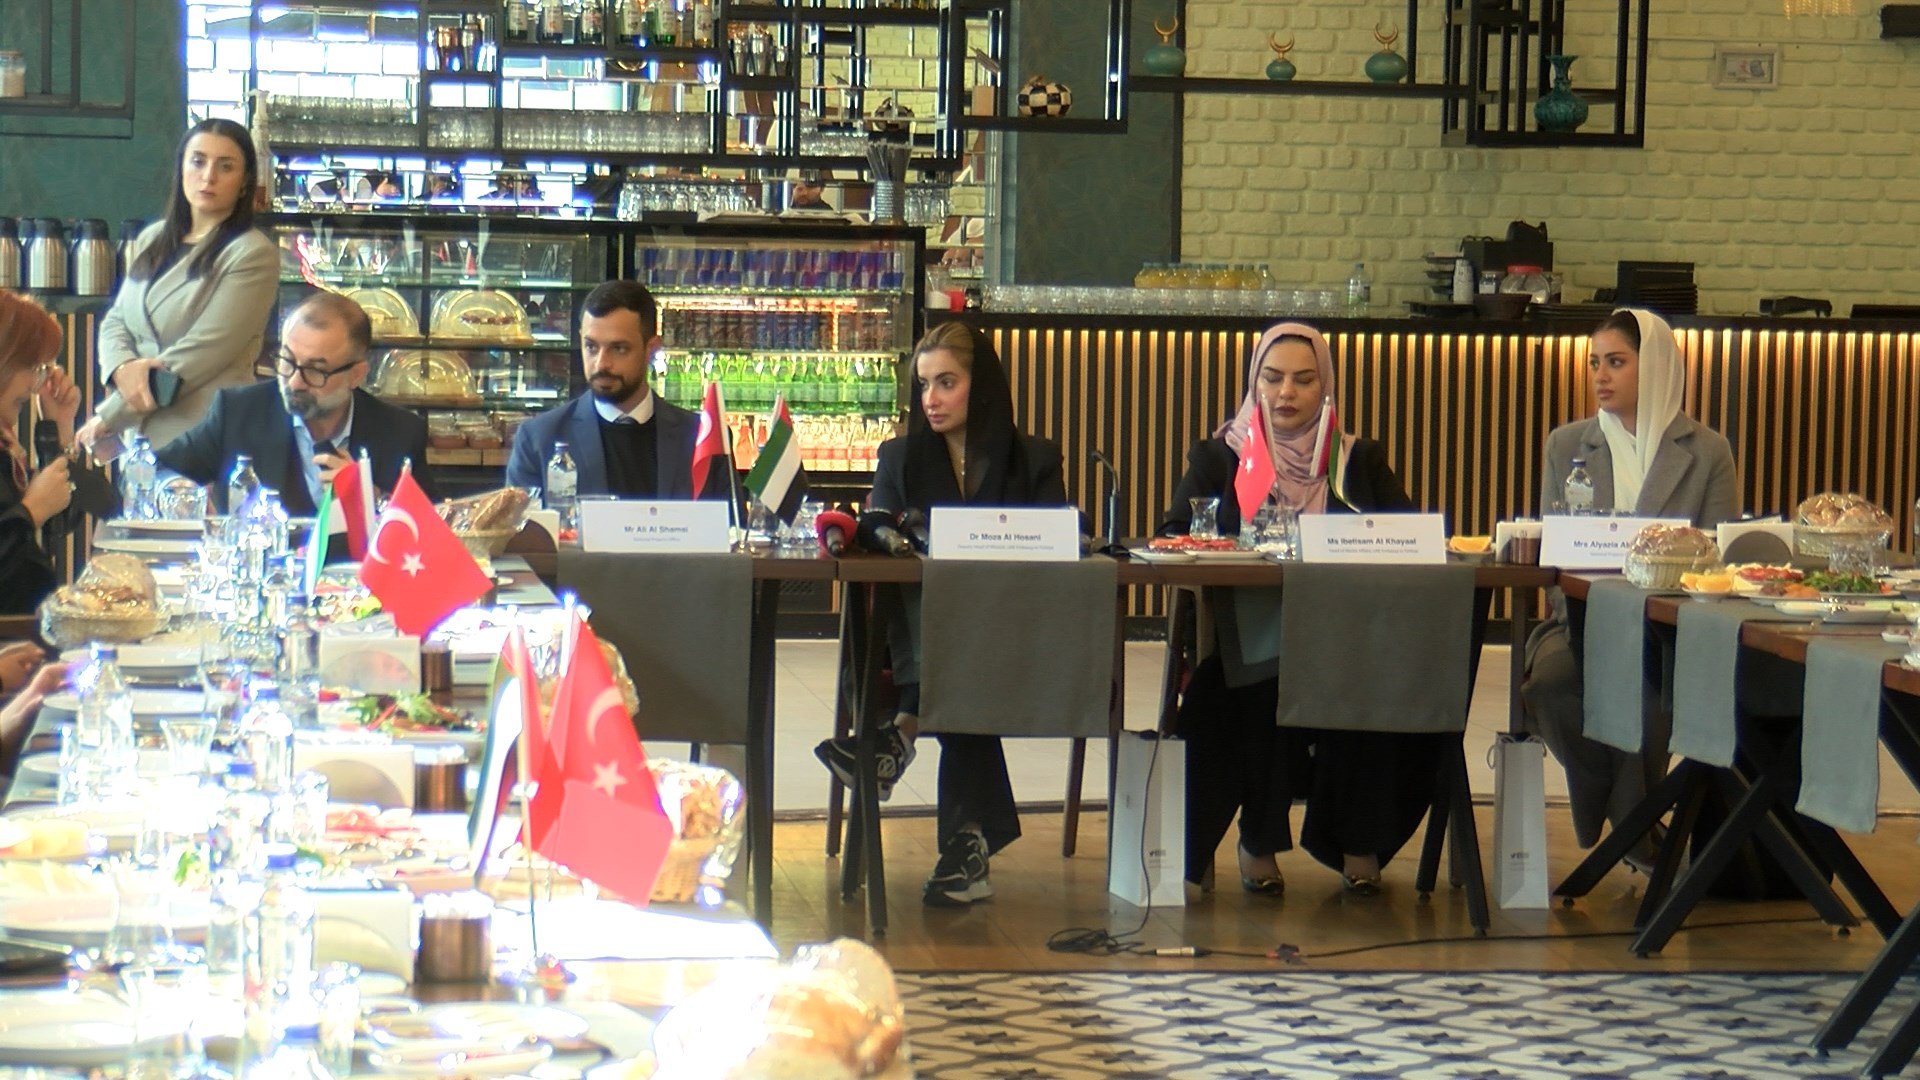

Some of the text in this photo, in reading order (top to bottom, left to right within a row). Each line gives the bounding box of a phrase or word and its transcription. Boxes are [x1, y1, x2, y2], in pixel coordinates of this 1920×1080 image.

[981, 533, 1002, 541] Moza
[1004, 533, 1012, 541] Al
[1573, 540, 1588, 548] Mrs
